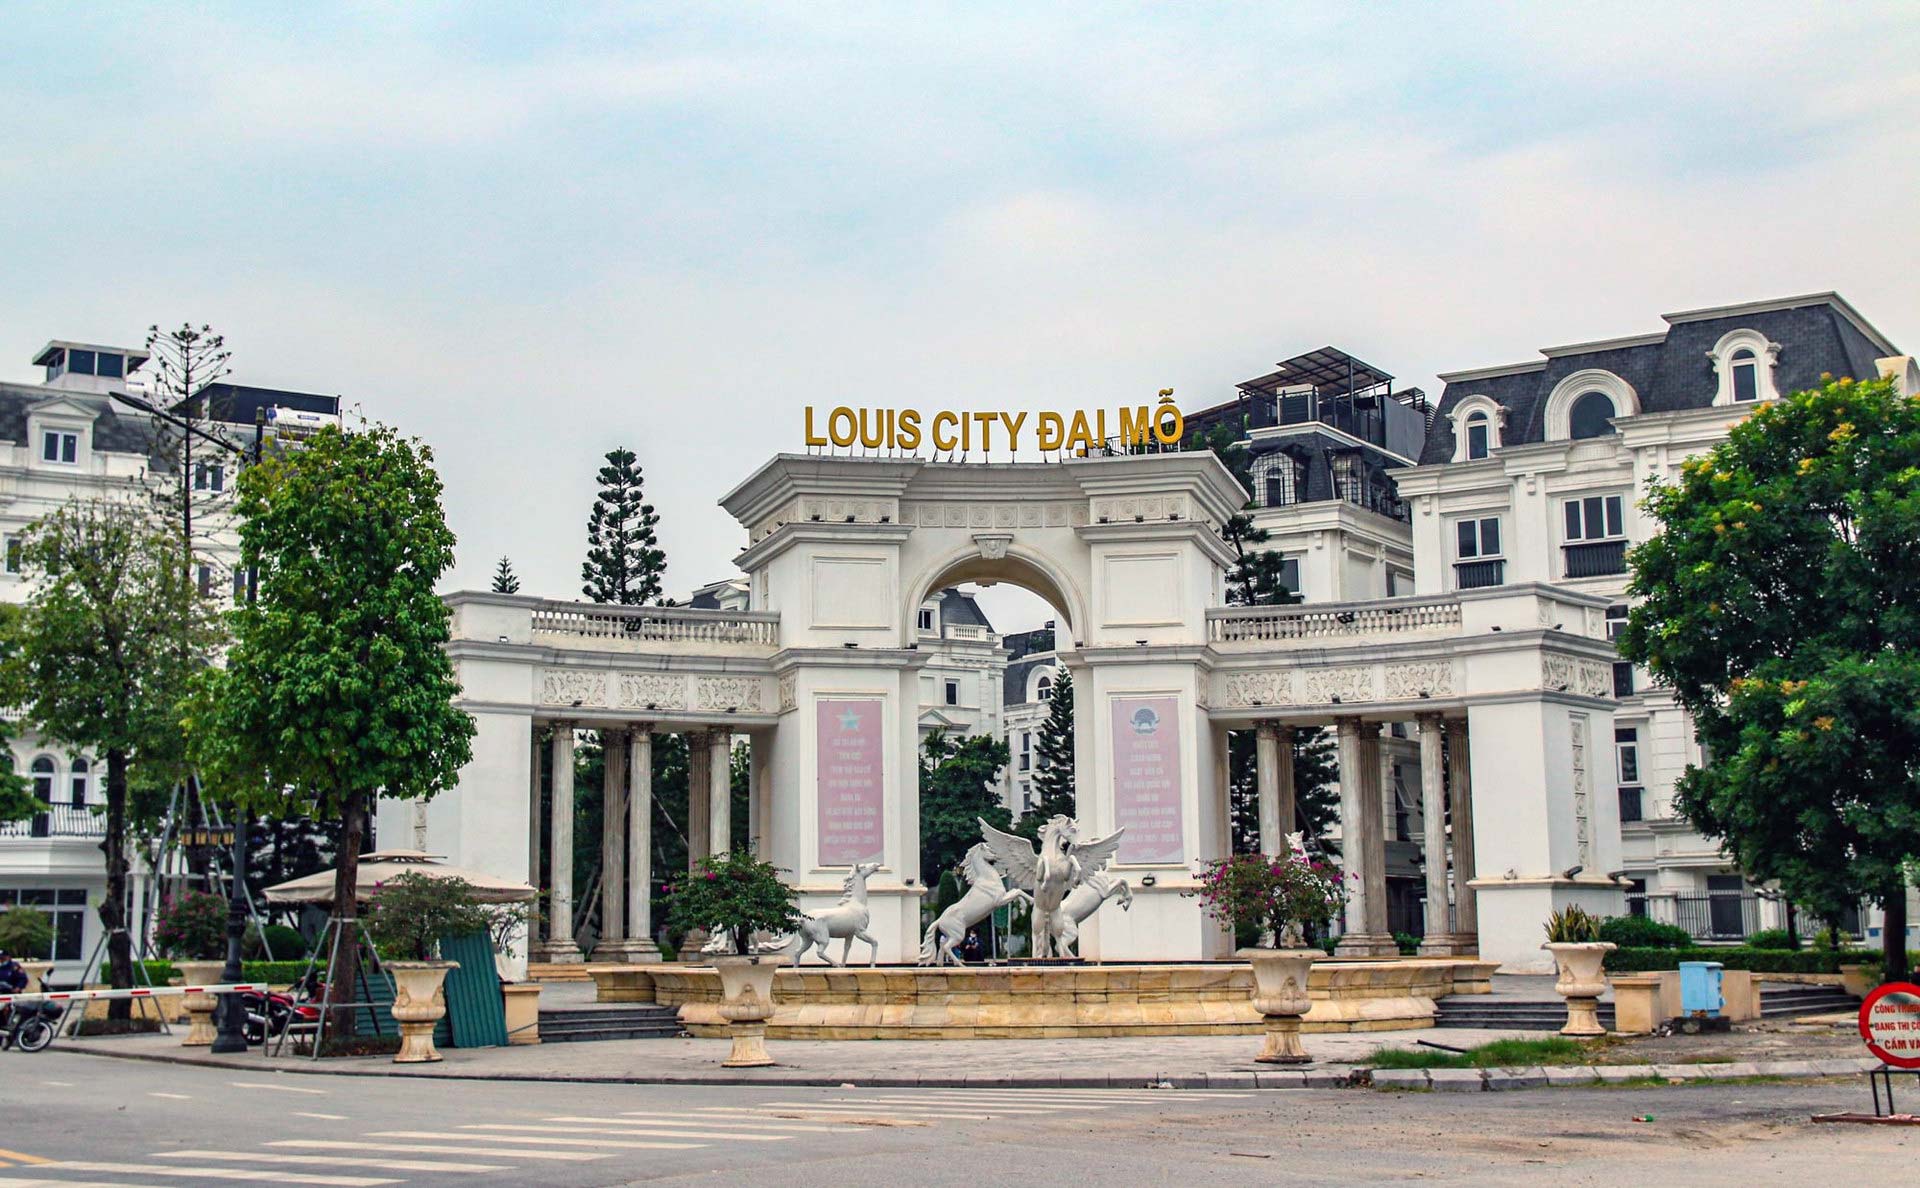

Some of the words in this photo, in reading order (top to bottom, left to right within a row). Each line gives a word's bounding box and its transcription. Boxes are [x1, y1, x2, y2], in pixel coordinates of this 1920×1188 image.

[804, 405, 921, 450] LOUIS
[932, 411, 1027, 452] CITY
[1036, 408, 1105, 458] ĐẠI
[1119, 388, 1184, 446] MỖ
